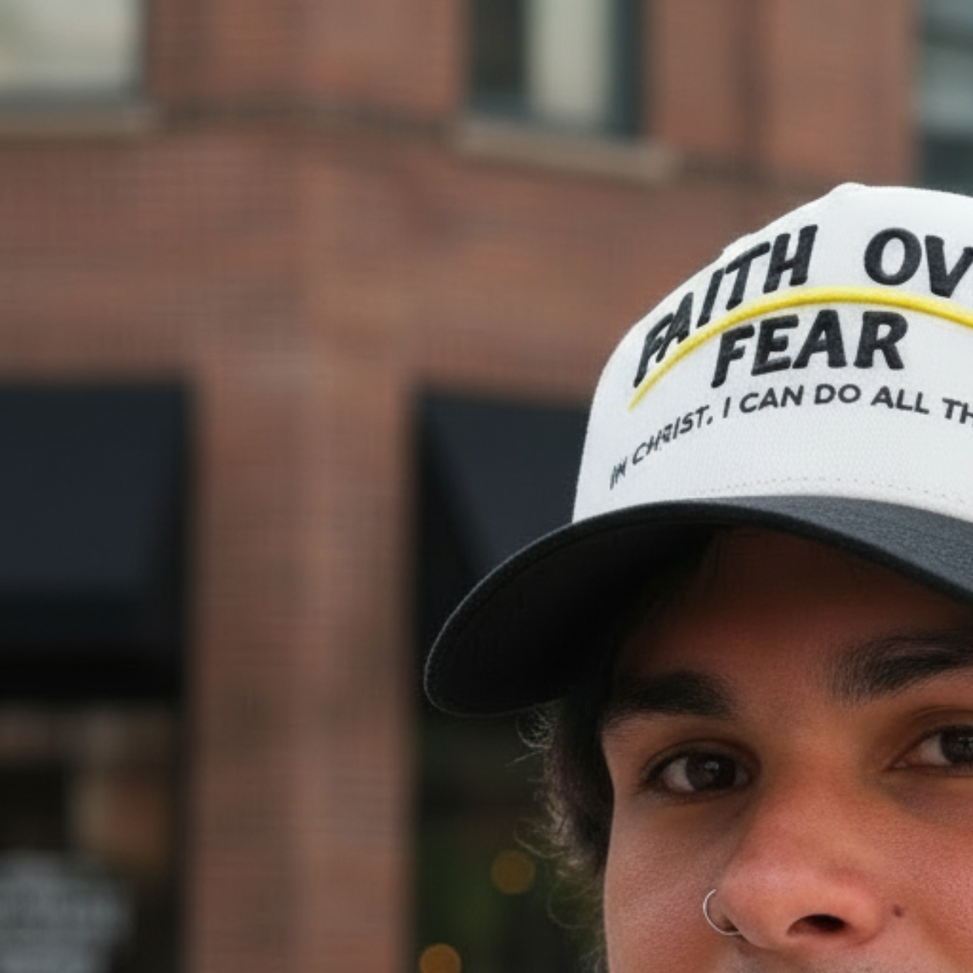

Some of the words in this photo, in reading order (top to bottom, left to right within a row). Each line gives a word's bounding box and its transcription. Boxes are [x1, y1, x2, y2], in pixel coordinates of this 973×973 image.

[633, 224, 818, 388] FAITH
[710, 308, 909, 389] FEAR
[723, 396, 731, 419] I
[739, 384, 804, 414] CAN
[814, 383, 862, 405] DO
[870, 385, 930, 415] ALL
